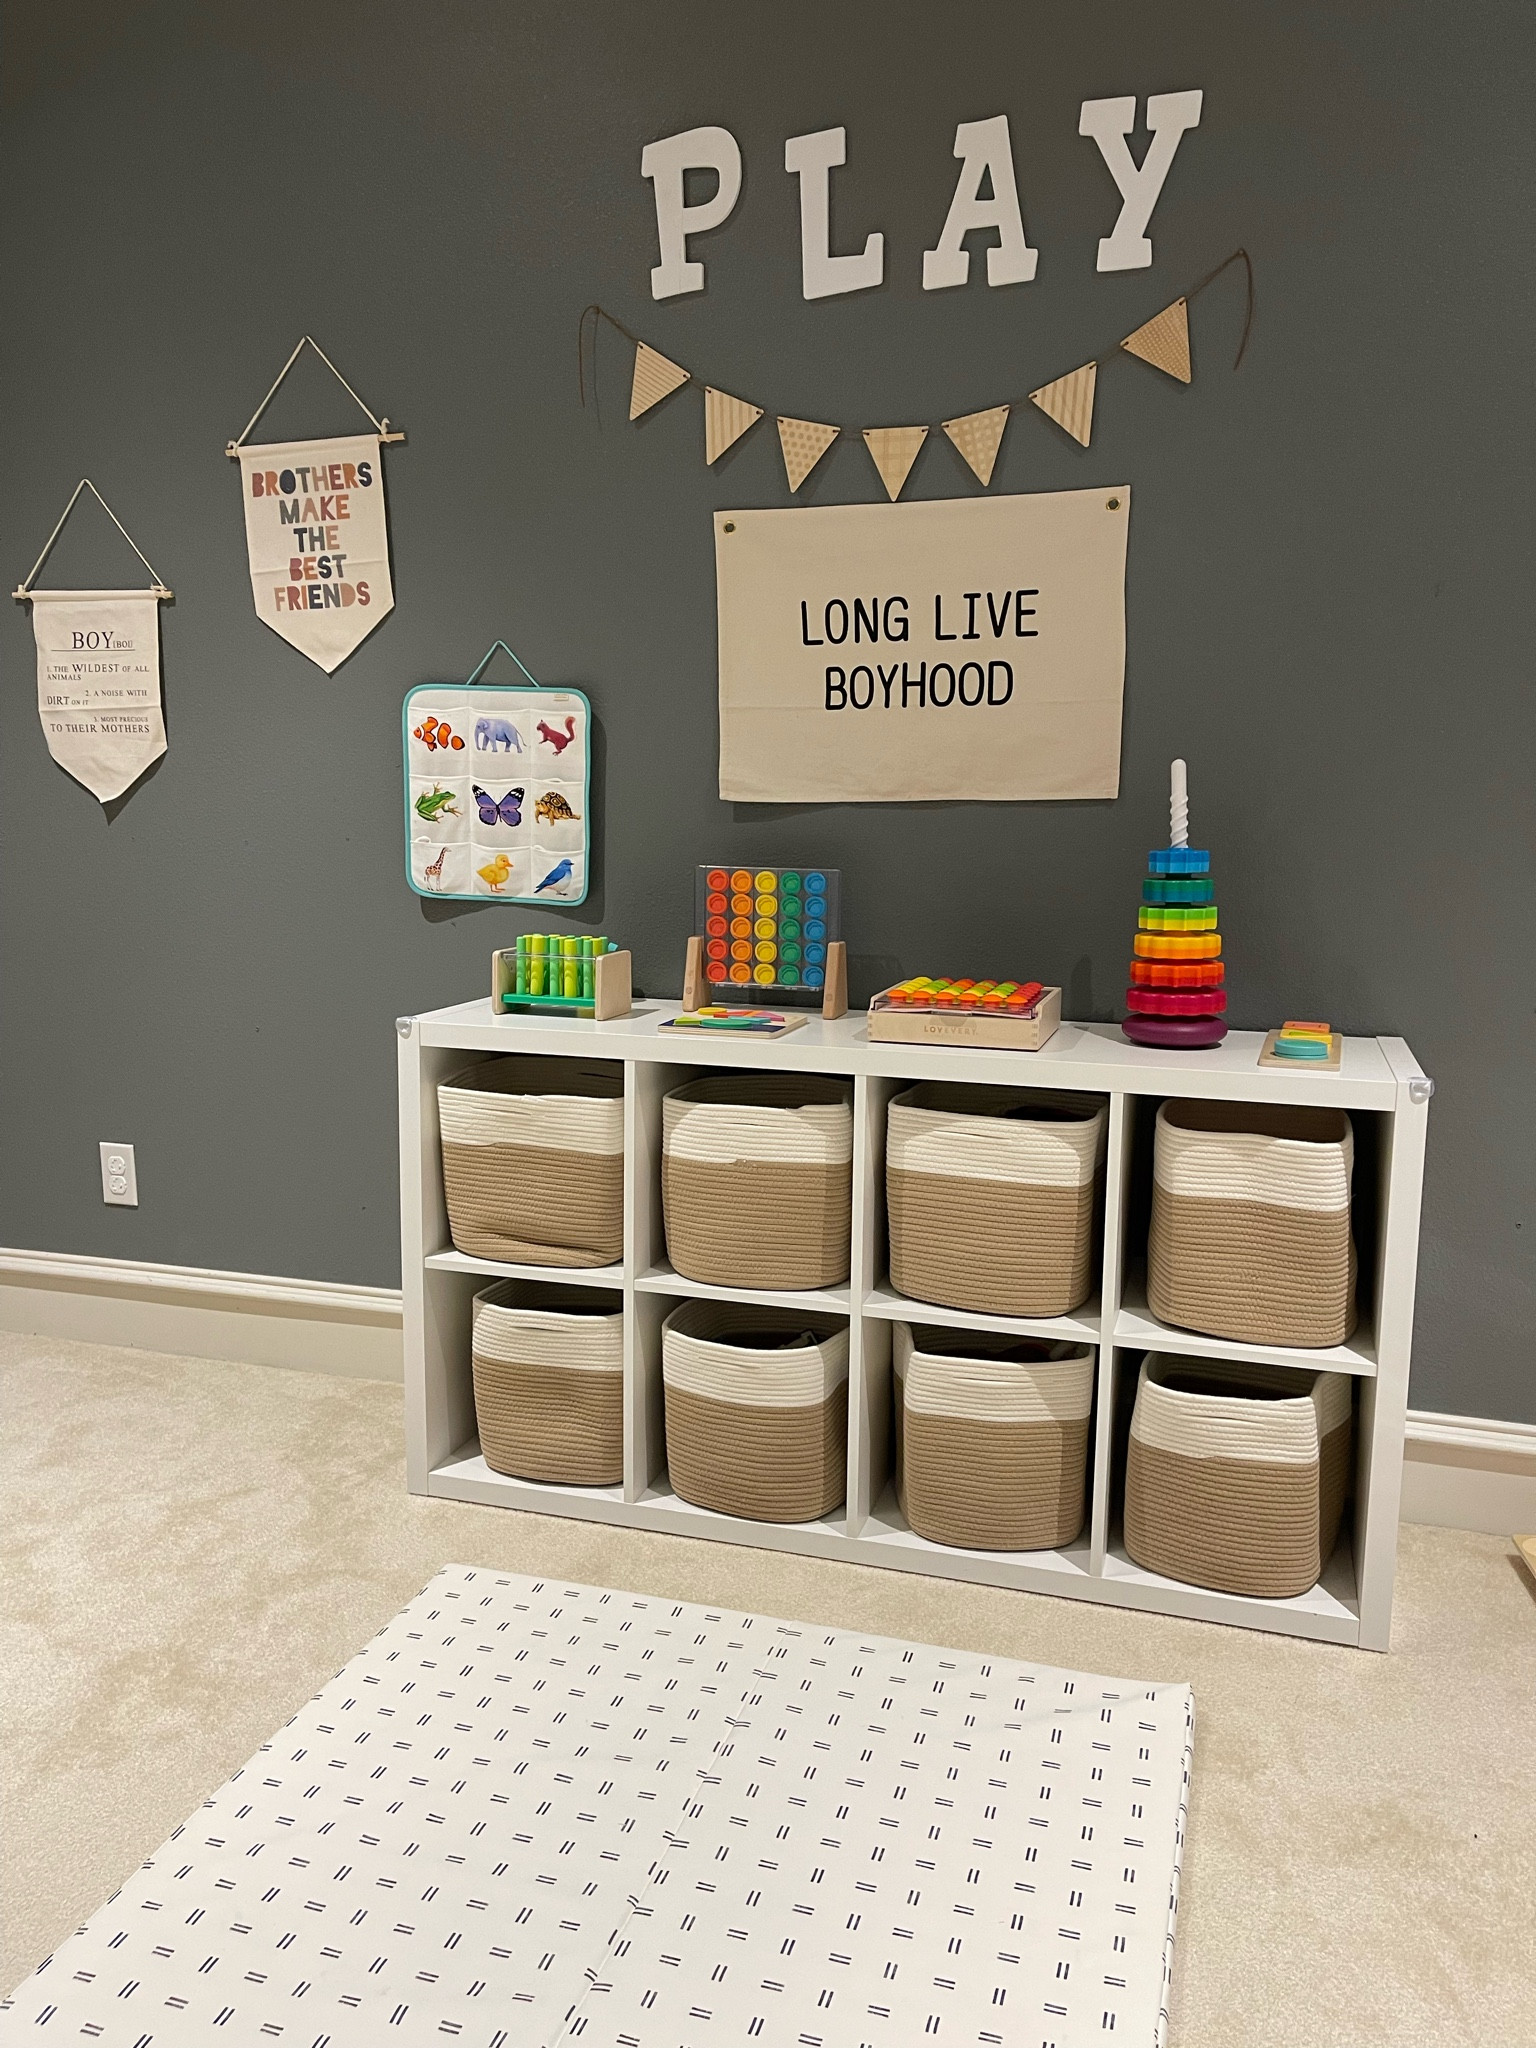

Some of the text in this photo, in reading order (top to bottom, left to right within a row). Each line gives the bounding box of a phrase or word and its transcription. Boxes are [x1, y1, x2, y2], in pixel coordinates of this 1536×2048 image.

[641, 89, 1203, 300] PLAY
[252, 462, 372, 498] BROTHERS
[279, 494, 350, 525] MAKE
[293, 525, 340, 552] THE
[289, 554, 347, 581] BEST
[273, 581, 371, 611] FRIENDS
[801, 589, 1040, 645] LONG LIVE
[71, 631, 114, 649] BOY
[46, 673, 82, 681] ANIMALS
[53, 665, 69, 673] THE
[72, 663, 119, 673] WILDEST
[100, 689, 124, 697] NOISE
[126, 689, 147, 697] WITH
[825, 660, 1014, 710] BOYHOOD
[47, 696, 70, 705] DIRT
[50, 723, 150, 733] TO THEIR MOTHERS
